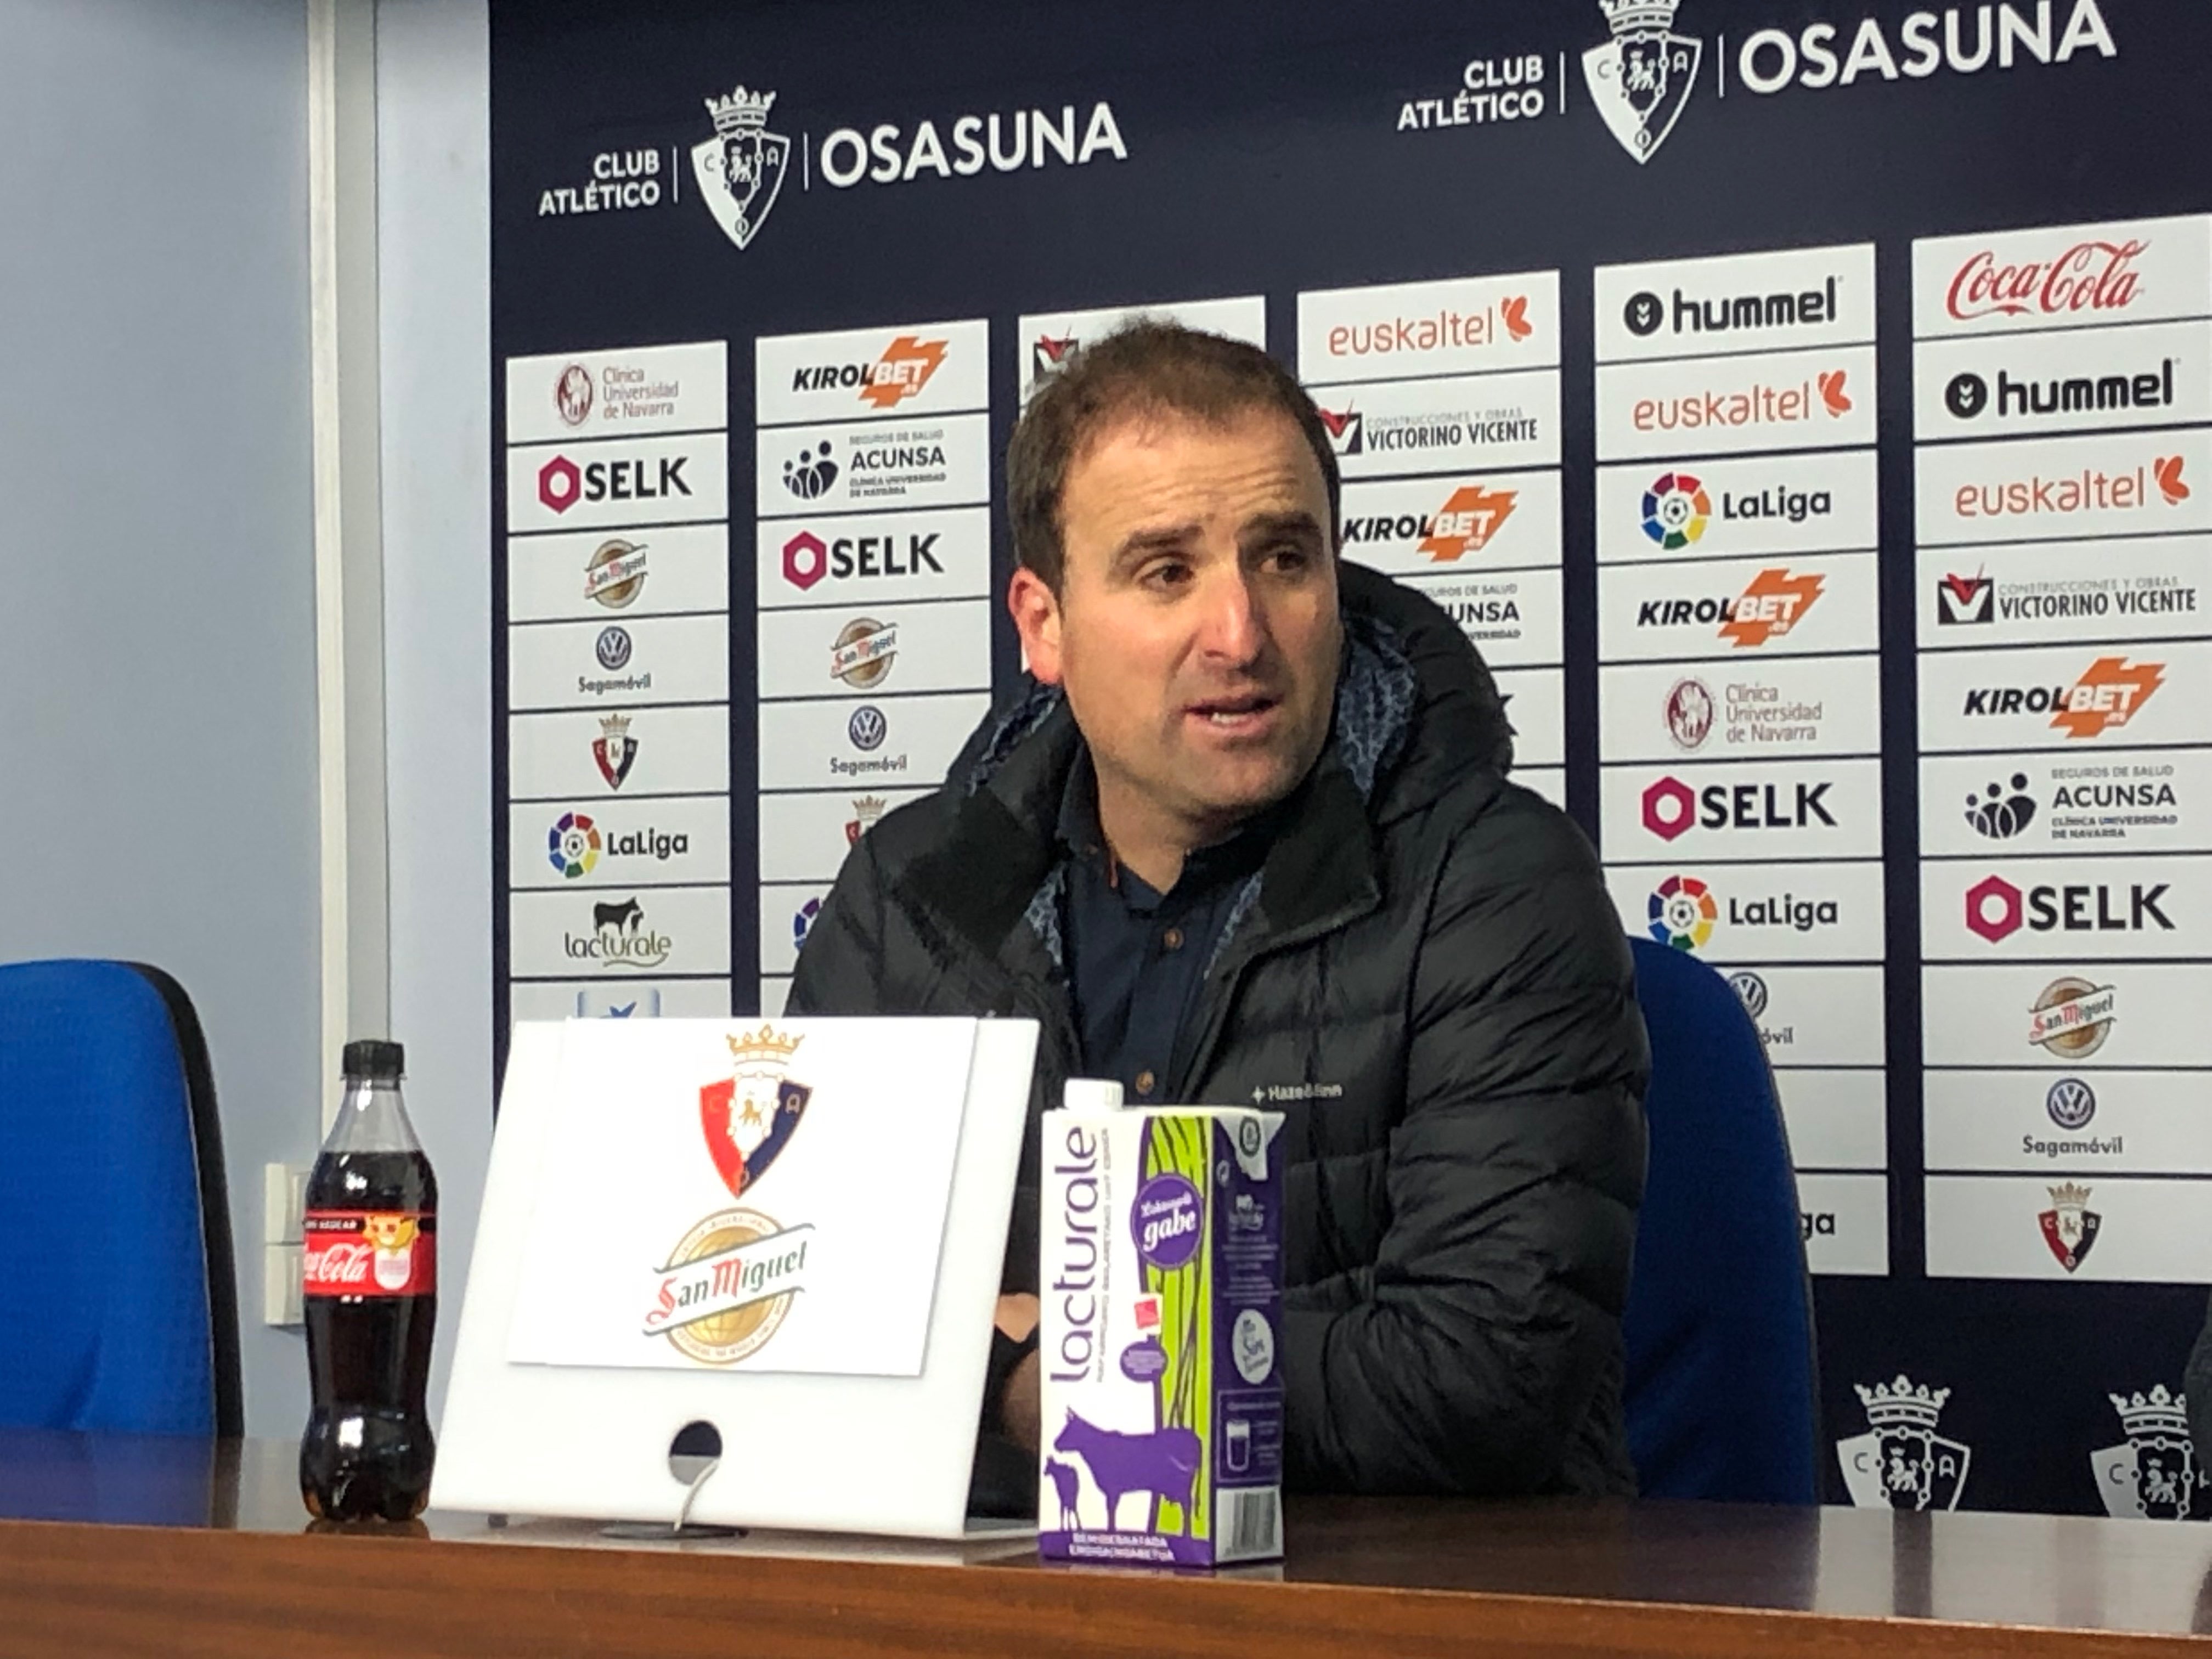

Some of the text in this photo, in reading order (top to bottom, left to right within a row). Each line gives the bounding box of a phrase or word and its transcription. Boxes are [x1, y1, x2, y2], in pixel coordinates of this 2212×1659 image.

[1464, 0, 2118, 93] CLUB OSASUNA
[1397, 88, 1544, 131] ATLÉTICO
[593, 102, 1127, 188] CLUB OSASUNA
[539, 175, 660, 217] ATLÉTICO
[1946, 240, 2152, 320] Coca-Cola
[1673, 276, 1838, 332] hummel
[1329, 307, 1493, 357] euskaltel
[604, 381, 678, 402] Universidad
[793, 359, 928, 392] KIROLBET
[1997, 360, 2172, 417] hummel
[604, 402, 674, 419] de Navarra
[1633, 382, 1810, 431] euskaltel
[1368, 419, 1537, 450] VICTORINO VICENTE
[851, 447, 945, 471] ACUNSA
[584, 457, 692, 502] SELK
[1956, 466, 2144, 517] euskaltel
[1723, 486, 1831, 522] LaLiga
[1344, 510, 1496, 543] KIROLBET
[831, 533, 945, 578] SELK
[2136, 576, 2177, 589] OBRAS
[1448, 601, 1520, 624] UNSA
[1637, 593, 1802, 627] KIROLBET
[2000, 589, 2196, 619] VICTORINO VICENTE
[1726, 702, 1822, 723] Universidad
[1964, 684, 2140, 715] KIROLBET
[1726, 724, 1816, 743] de Navarra
[1701, 782, 1838, 828] SELK
[2052, 783, 2176, 809] ACUNSA
[607, 827, 688, 860] LaLiga
[1730, 894, 1838, 930] LaLiga
[2028, 883, 2176, 930] SELK
[565, 932, 672, 959] lacturale
[1143, 1206, 1196, 1252] gabe
[1050, 1126, 1097, 1383] lacturale
